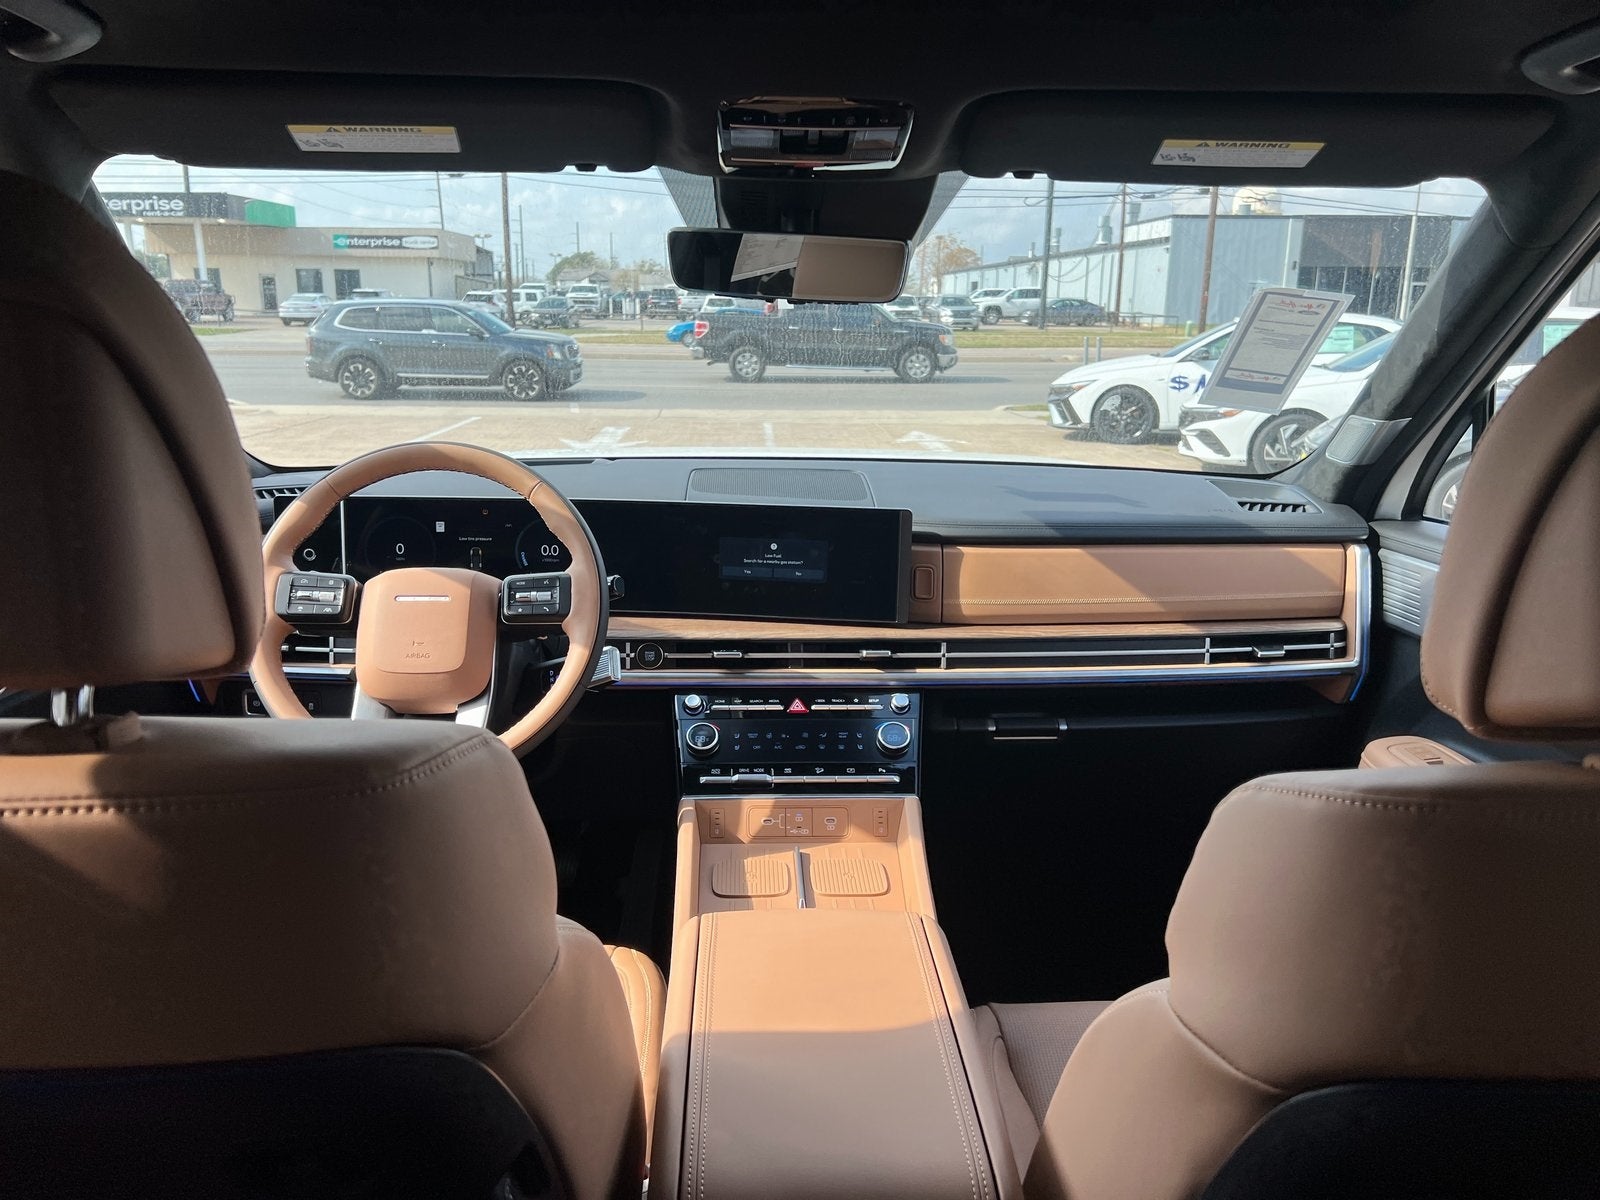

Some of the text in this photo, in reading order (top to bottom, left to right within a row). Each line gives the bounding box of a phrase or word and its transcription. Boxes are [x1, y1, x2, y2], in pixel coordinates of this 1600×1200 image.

[1215, 141, 1292, 149] WARNING
[335, 236, 401, 248] enterprise
[395, 543, 405, 555] 0
[540, 544, 560, 556] 0.0
